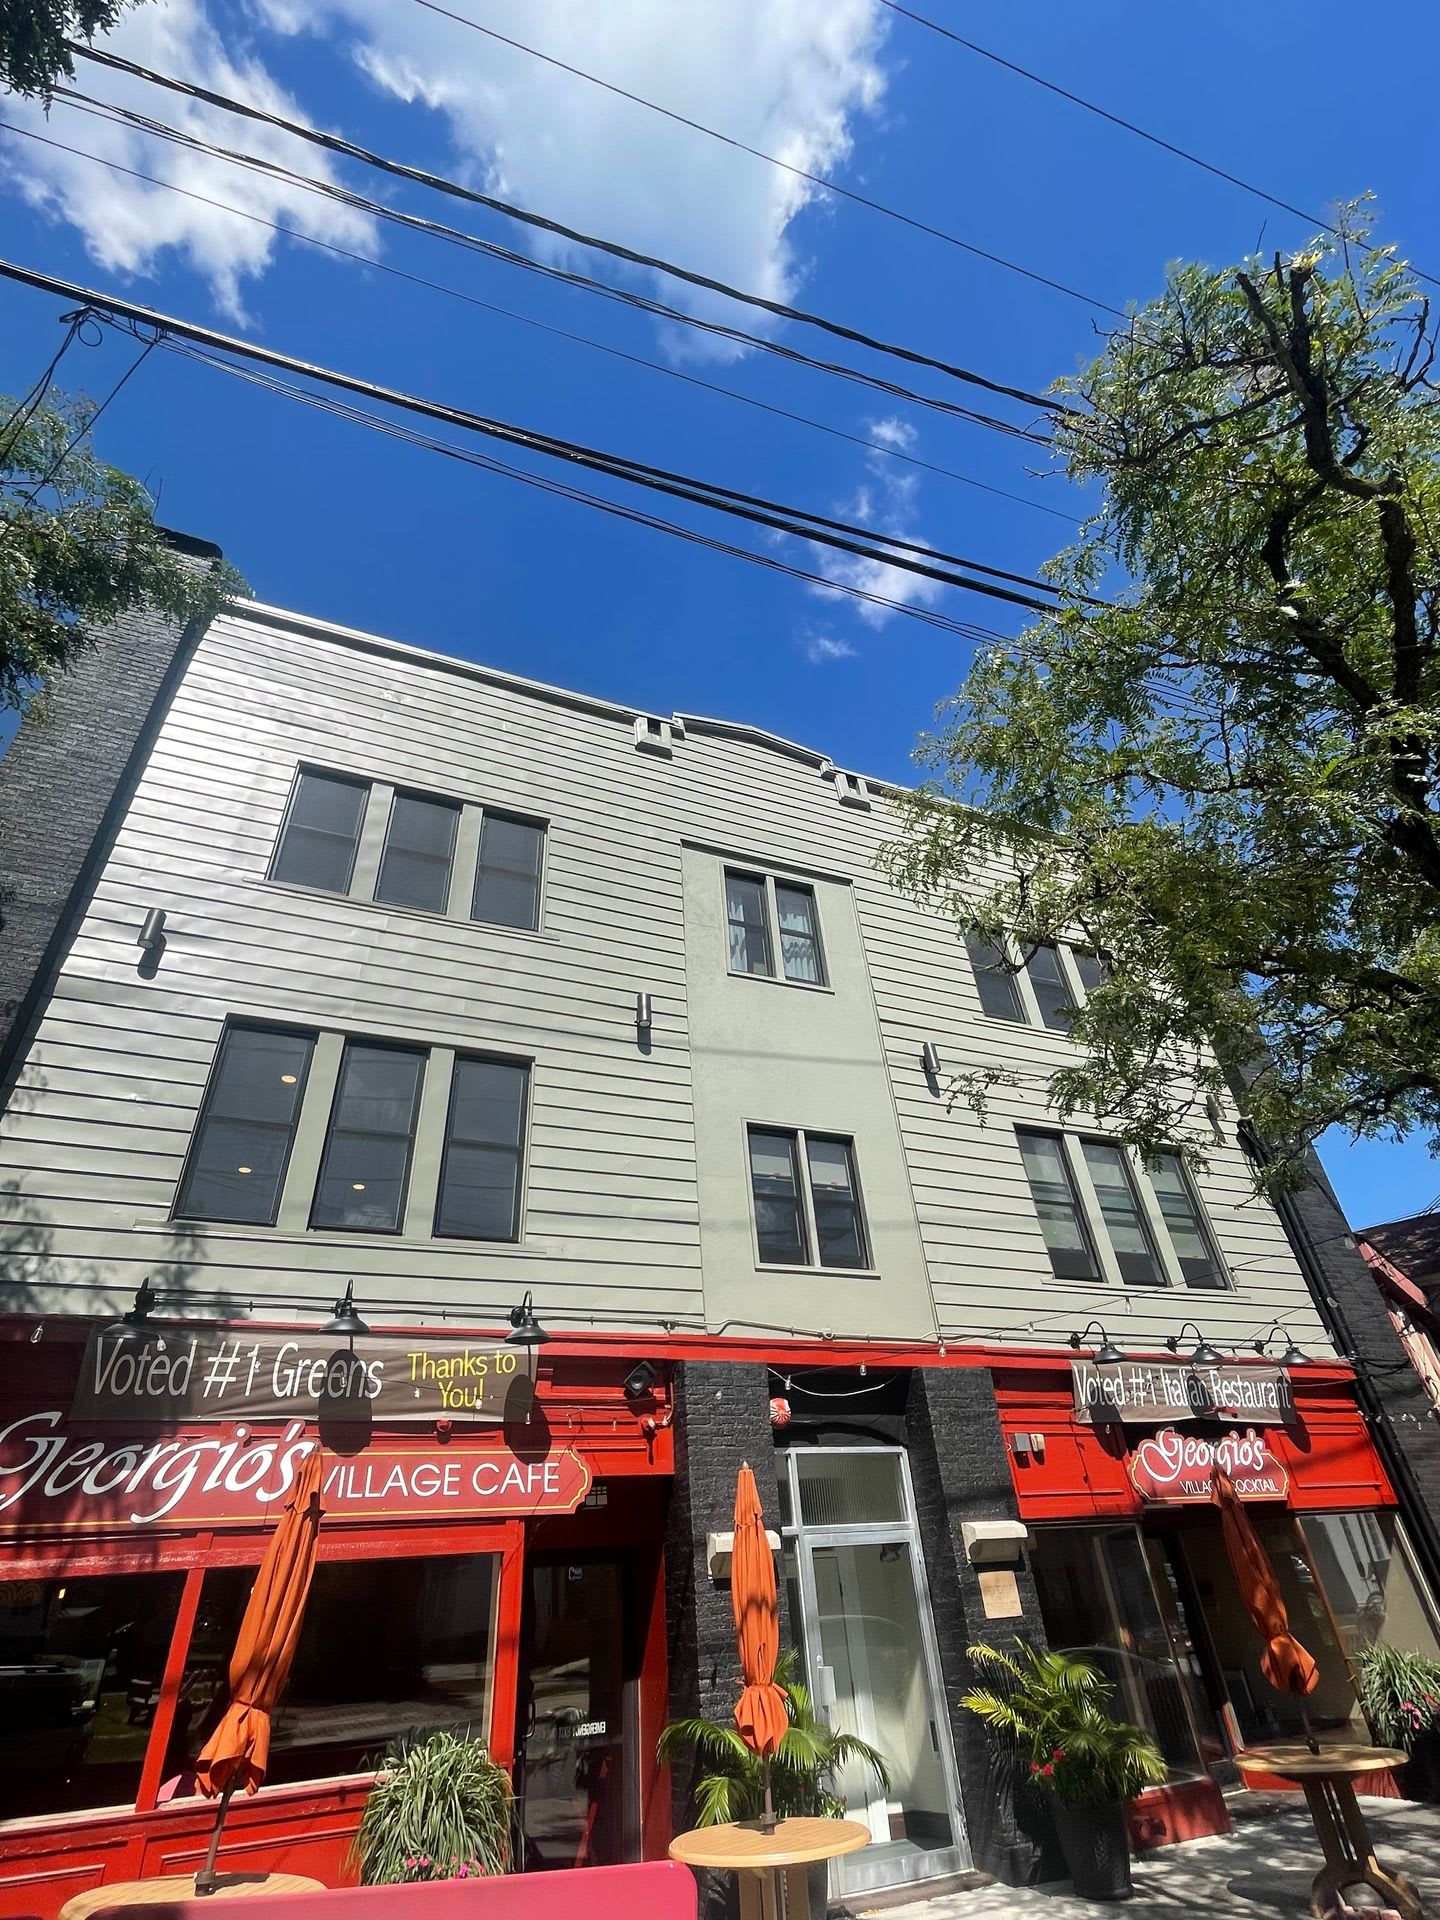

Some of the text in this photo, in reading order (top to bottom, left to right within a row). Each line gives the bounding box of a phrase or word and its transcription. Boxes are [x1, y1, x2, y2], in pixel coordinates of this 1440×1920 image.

[94, 1336, 384, 1399] Voted #1 Greens
[407, 1350, 516, 1380] Thanks to
[1073, 1365, 1292, 1409] Voted #1 Italian Restaurant
[0, 1411, 316, 1524] Georgio's
[472, 1462, 560, 1494] CAFE
[1141, 1426, 1264, 1482] Georgio's
